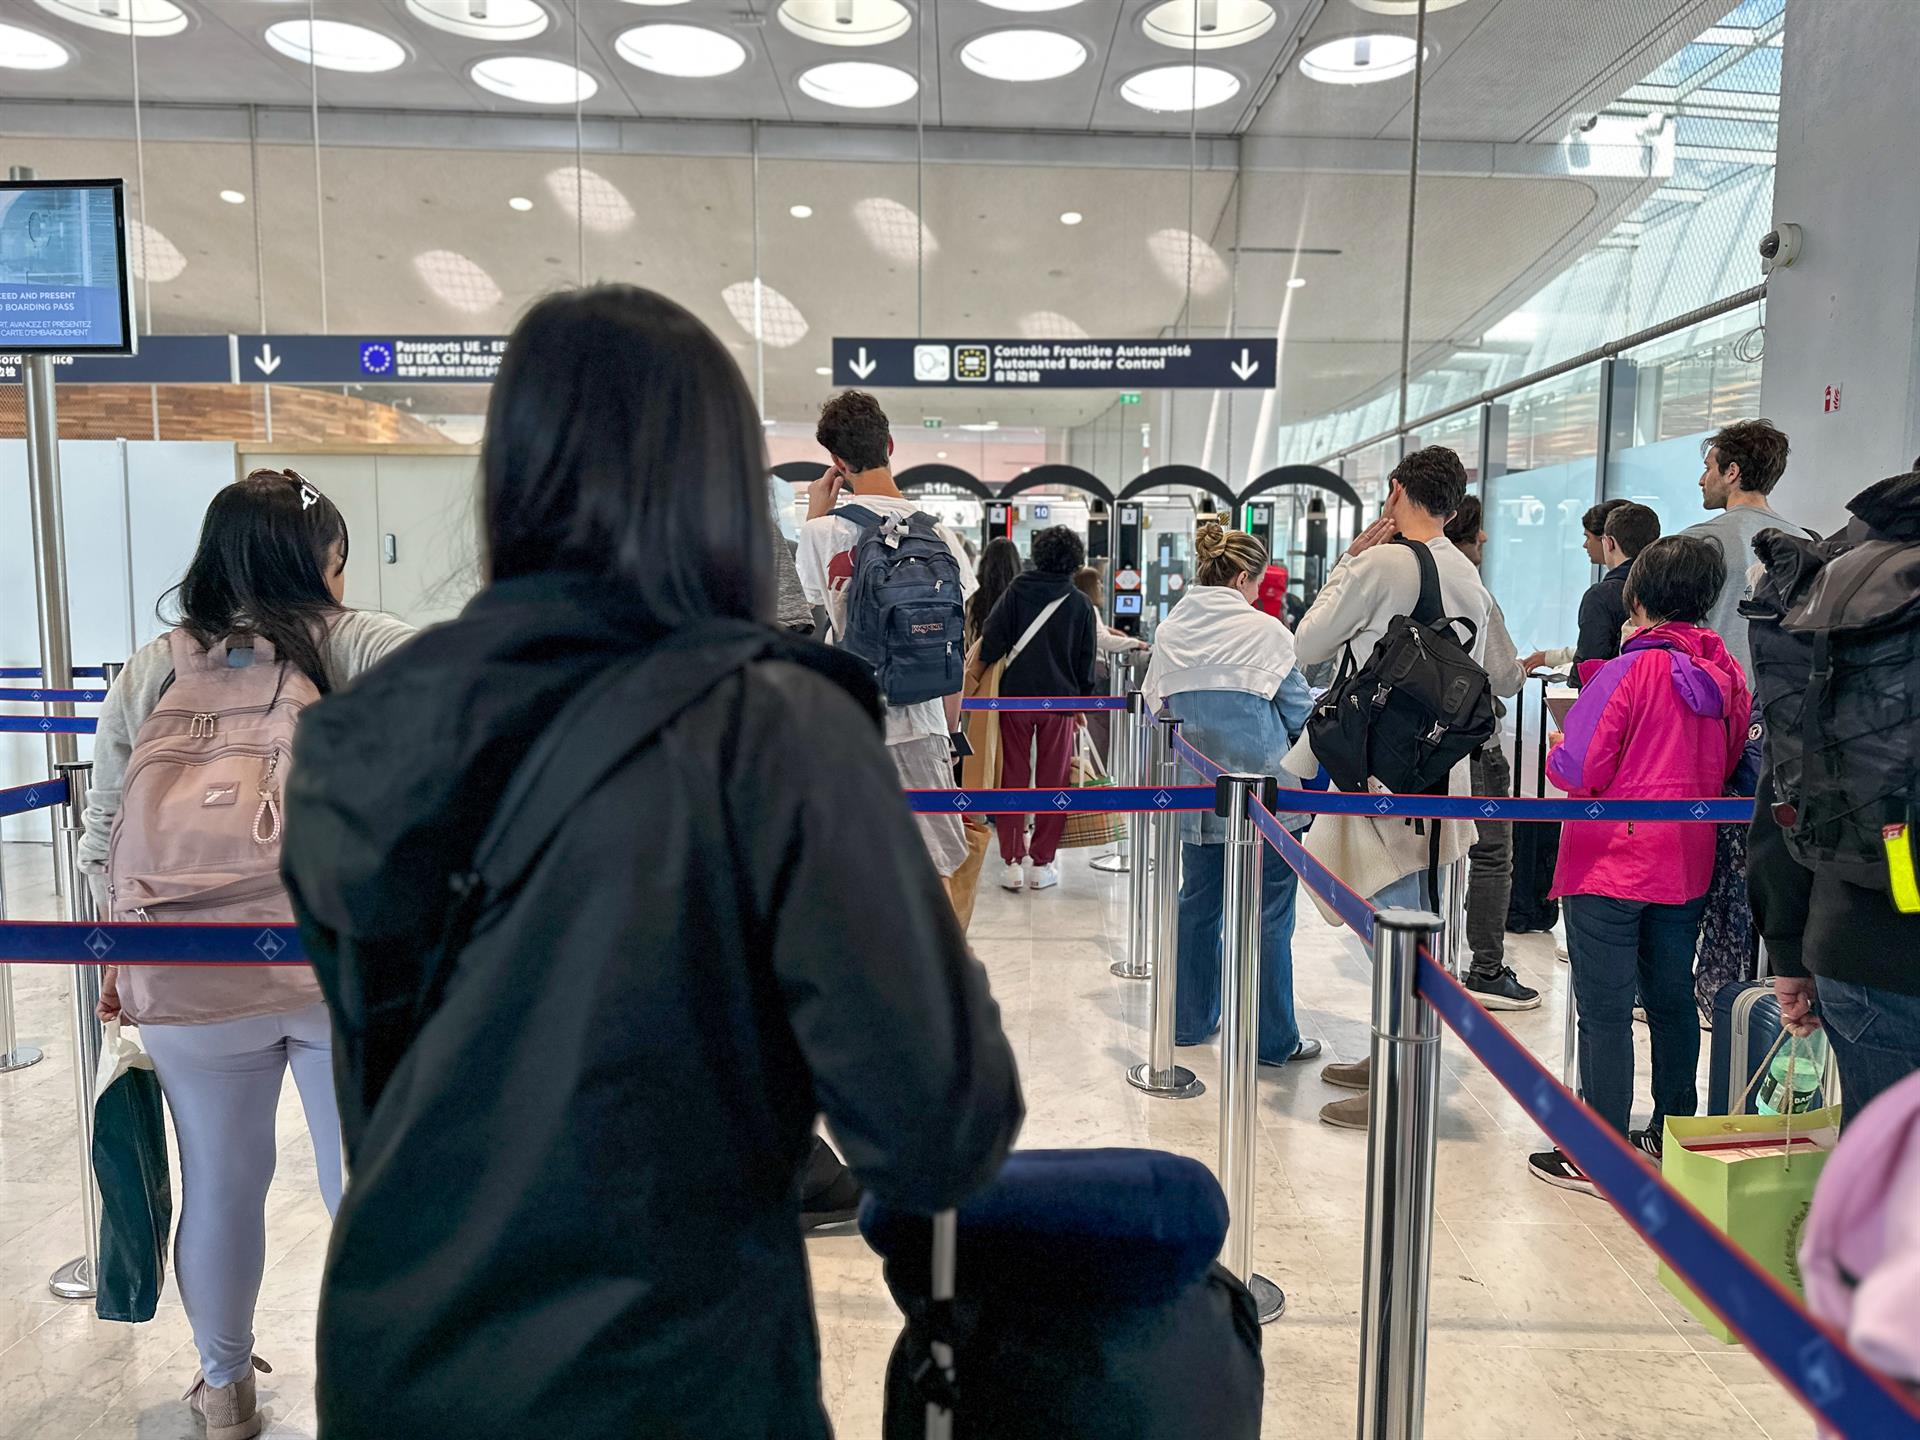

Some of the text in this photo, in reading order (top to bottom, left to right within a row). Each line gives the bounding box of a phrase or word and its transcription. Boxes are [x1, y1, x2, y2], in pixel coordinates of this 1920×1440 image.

[20, 292, 38, 300] AND
[40, 292, 76, 300] PRESENT
[5, 303, 51, 311] BOARDING
[53, 302, 75, 311] PASS
[43, 320, 51, 328] ET
[396, 340, 461, 353] Passeports
[463, 341, 481, 352] UE
[491, 341, 508, 352] EE
[994, 345, 1192, 357] Contrôle Frontière Automatisé
[396, 353, 413, 365] EU
[415, 353, 440, 365] EEA
[442, 353, 461, 365] CH
[994, 357, 1165, 370] Automated Border Control
[1035, 508, 1048, 518] 10
[1126, 512, 1132, 521] 3
[1257, 512, 1264, 520] 2
